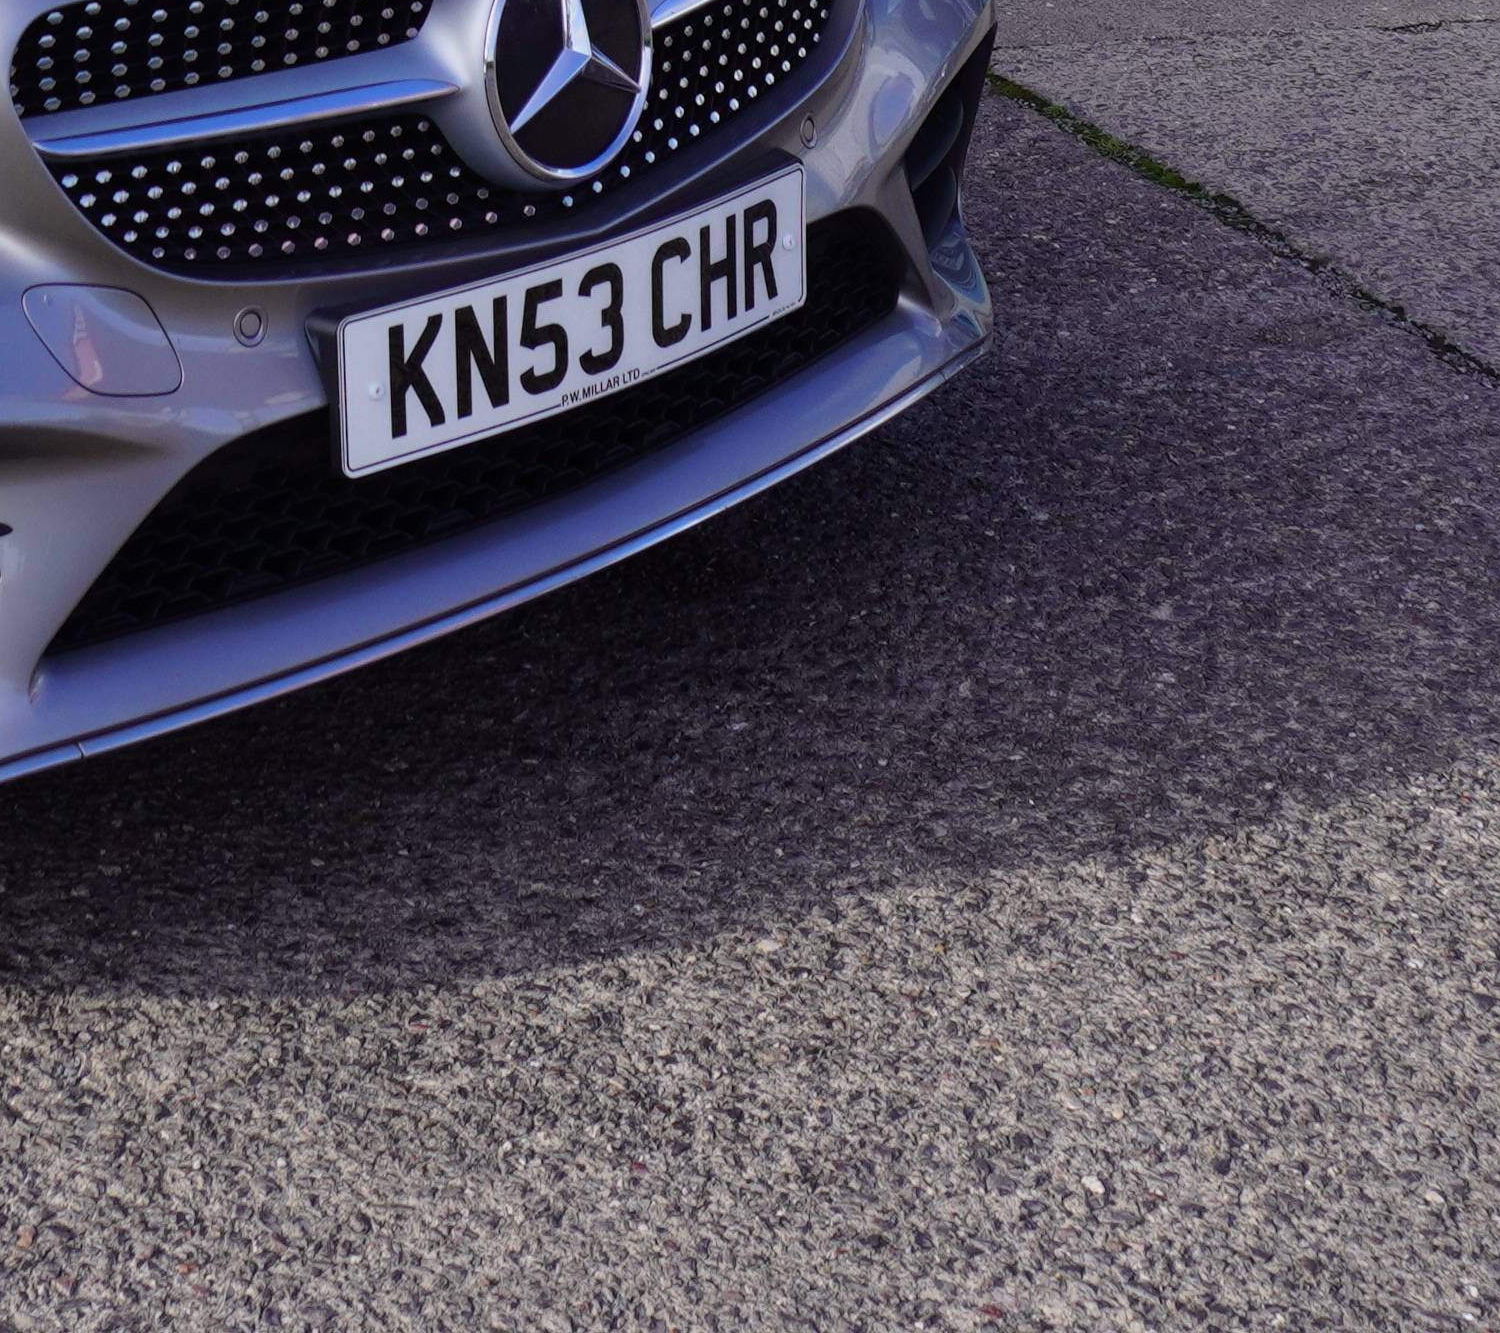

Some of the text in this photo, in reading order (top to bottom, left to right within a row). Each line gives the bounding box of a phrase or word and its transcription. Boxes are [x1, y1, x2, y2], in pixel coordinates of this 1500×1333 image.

[388, 199, 781, 440] KN53 CHR
[622, 367, 641, 385] LTD
